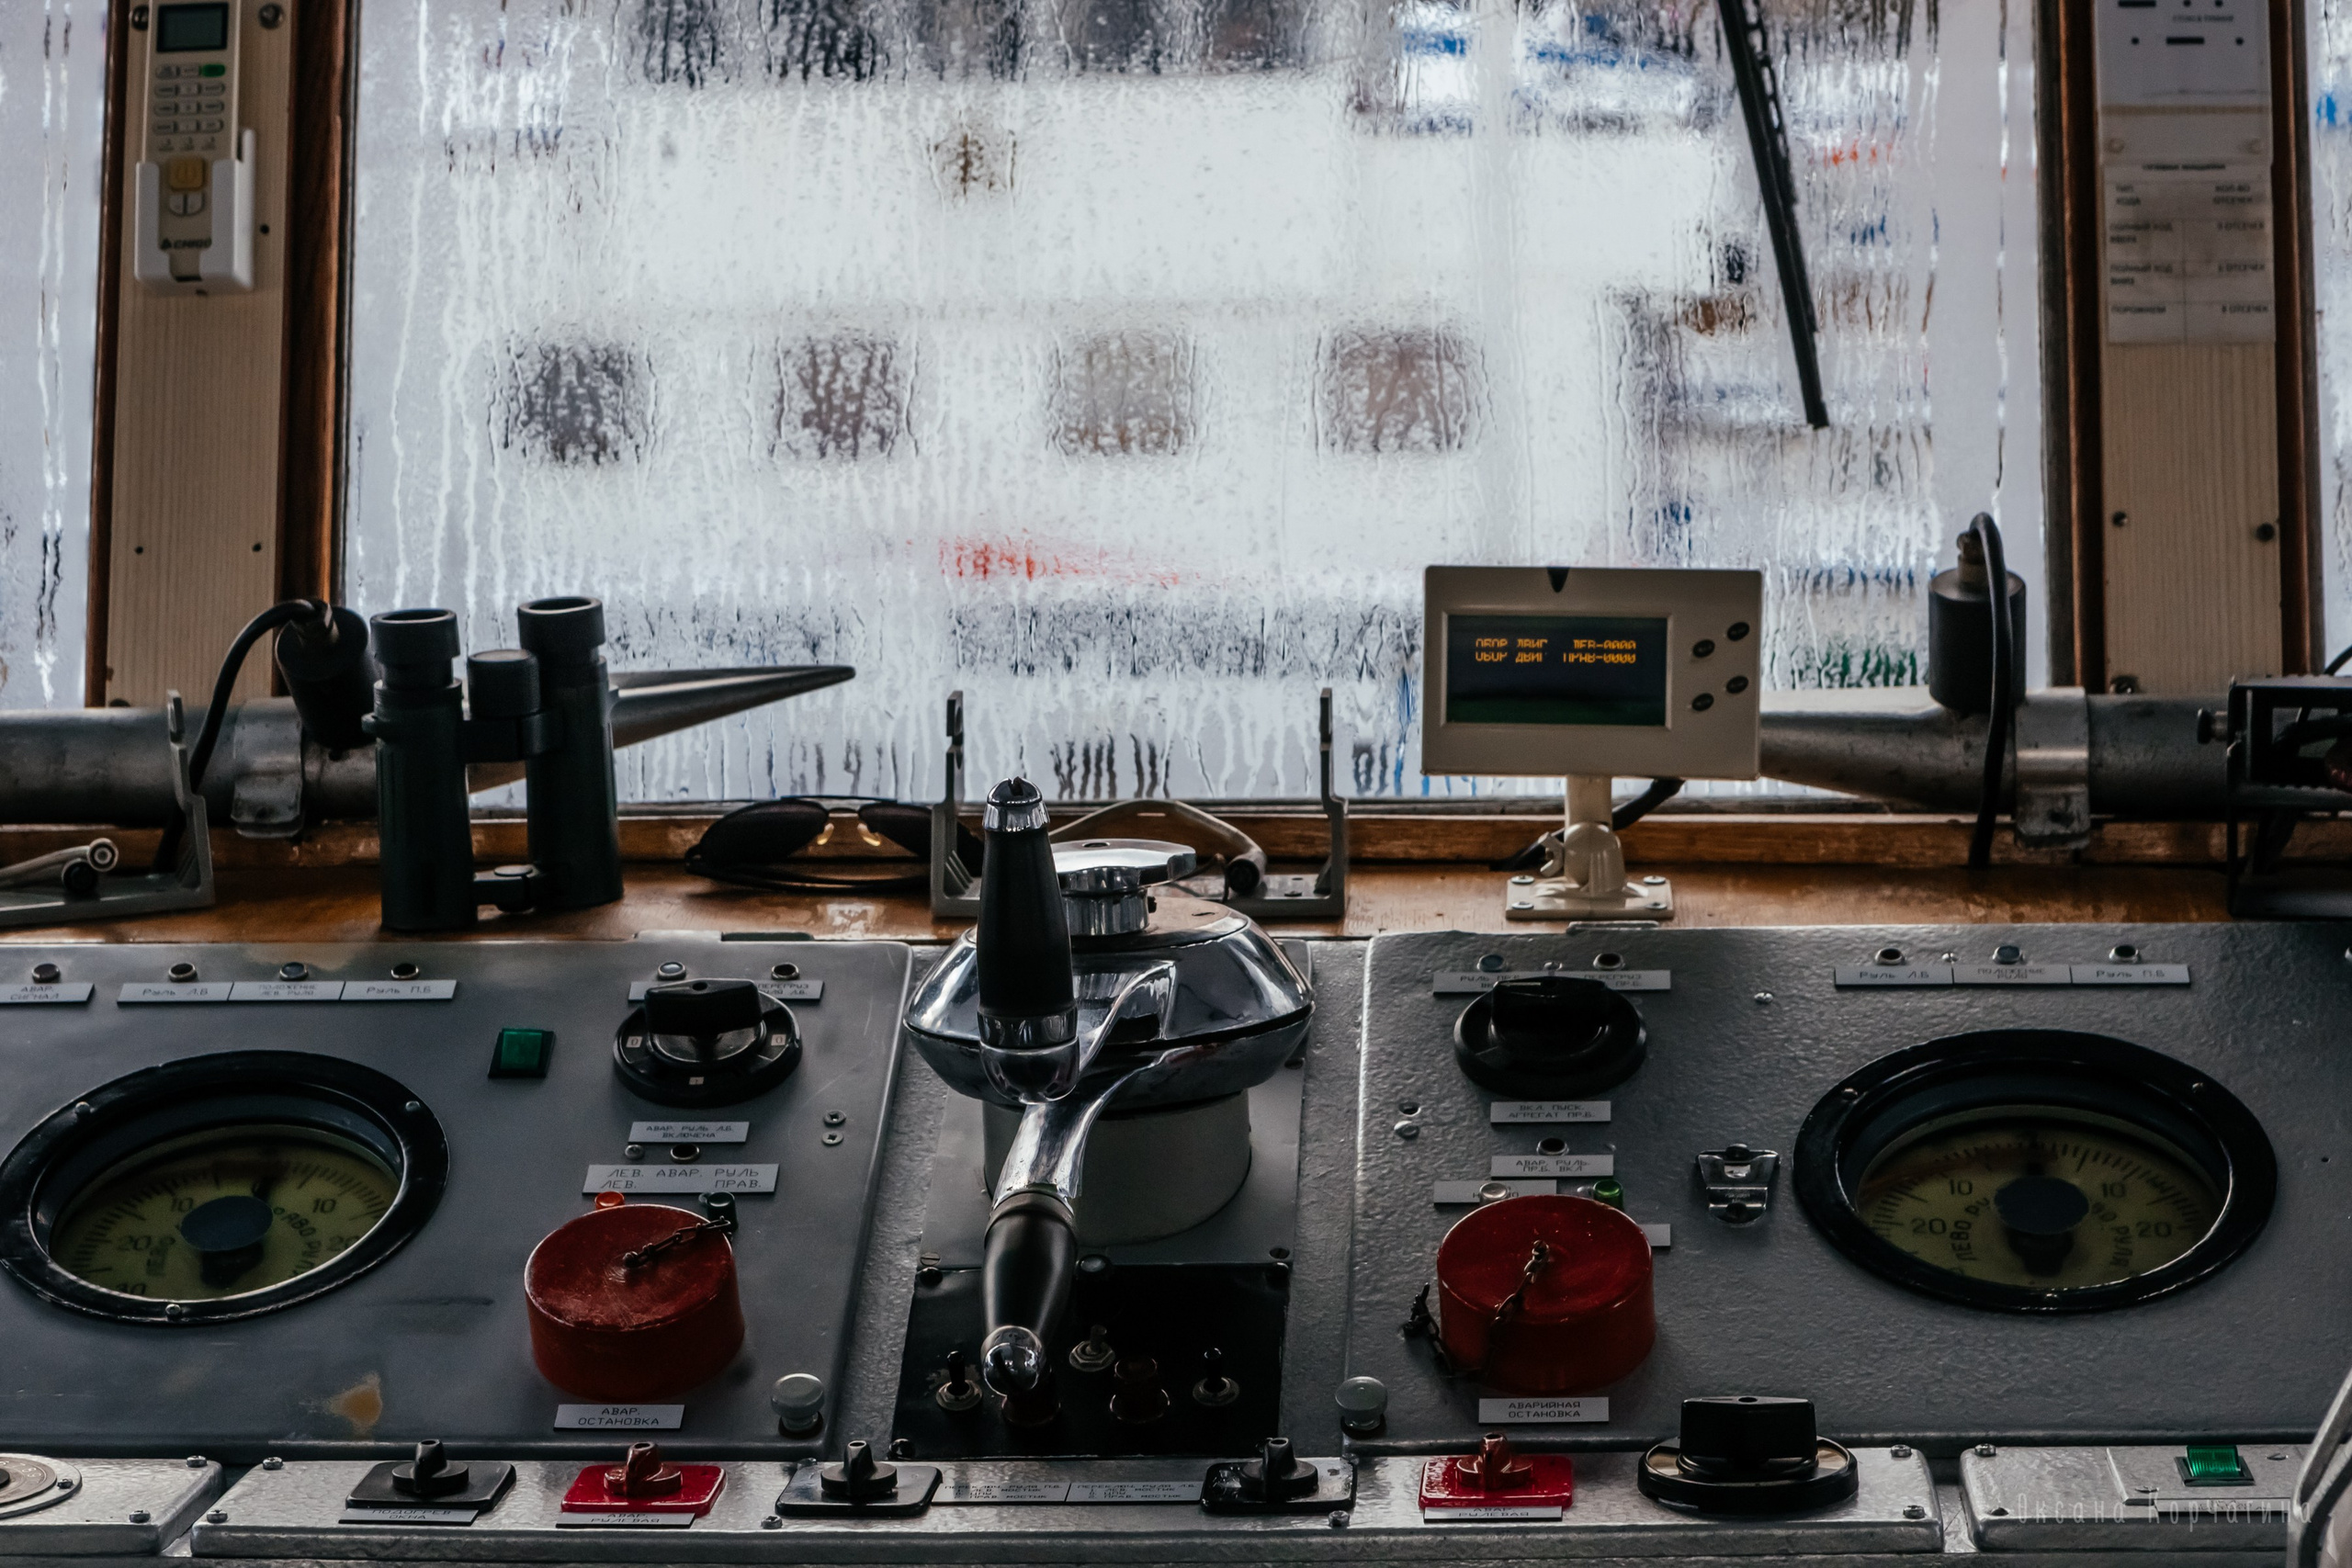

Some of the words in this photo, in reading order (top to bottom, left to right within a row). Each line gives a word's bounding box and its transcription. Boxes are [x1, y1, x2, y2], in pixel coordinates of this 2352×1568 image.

[607, 1168, 644, 1178] ЛЕВ.
[655, 1168, 703, 1178] АВАР.
[714, 1168, 759, 1177] РУЛЬ
[600, 1180, 638, 1189] ЛЕВ.
[714, 1179, 762, 1189] ПРАВ.
[1949, 1179, 1973, 1195] 10
[2101, 1181, 2127, 1199] 10
[312, 1198, 337, 1214] 10
[1910, 1218, 1948, 1235] 20
[2135, 1221, 2173, 1238] 20
[1508, 1401, 1581, 1409] АВАРИЙНАЯ
[601, 1407, 640, 1416] АВАР.
[1508, 1410, 1581, 1418] ОСТАНОВКА
[578, 1417, 660, 1426] ОСТАНОВКА
